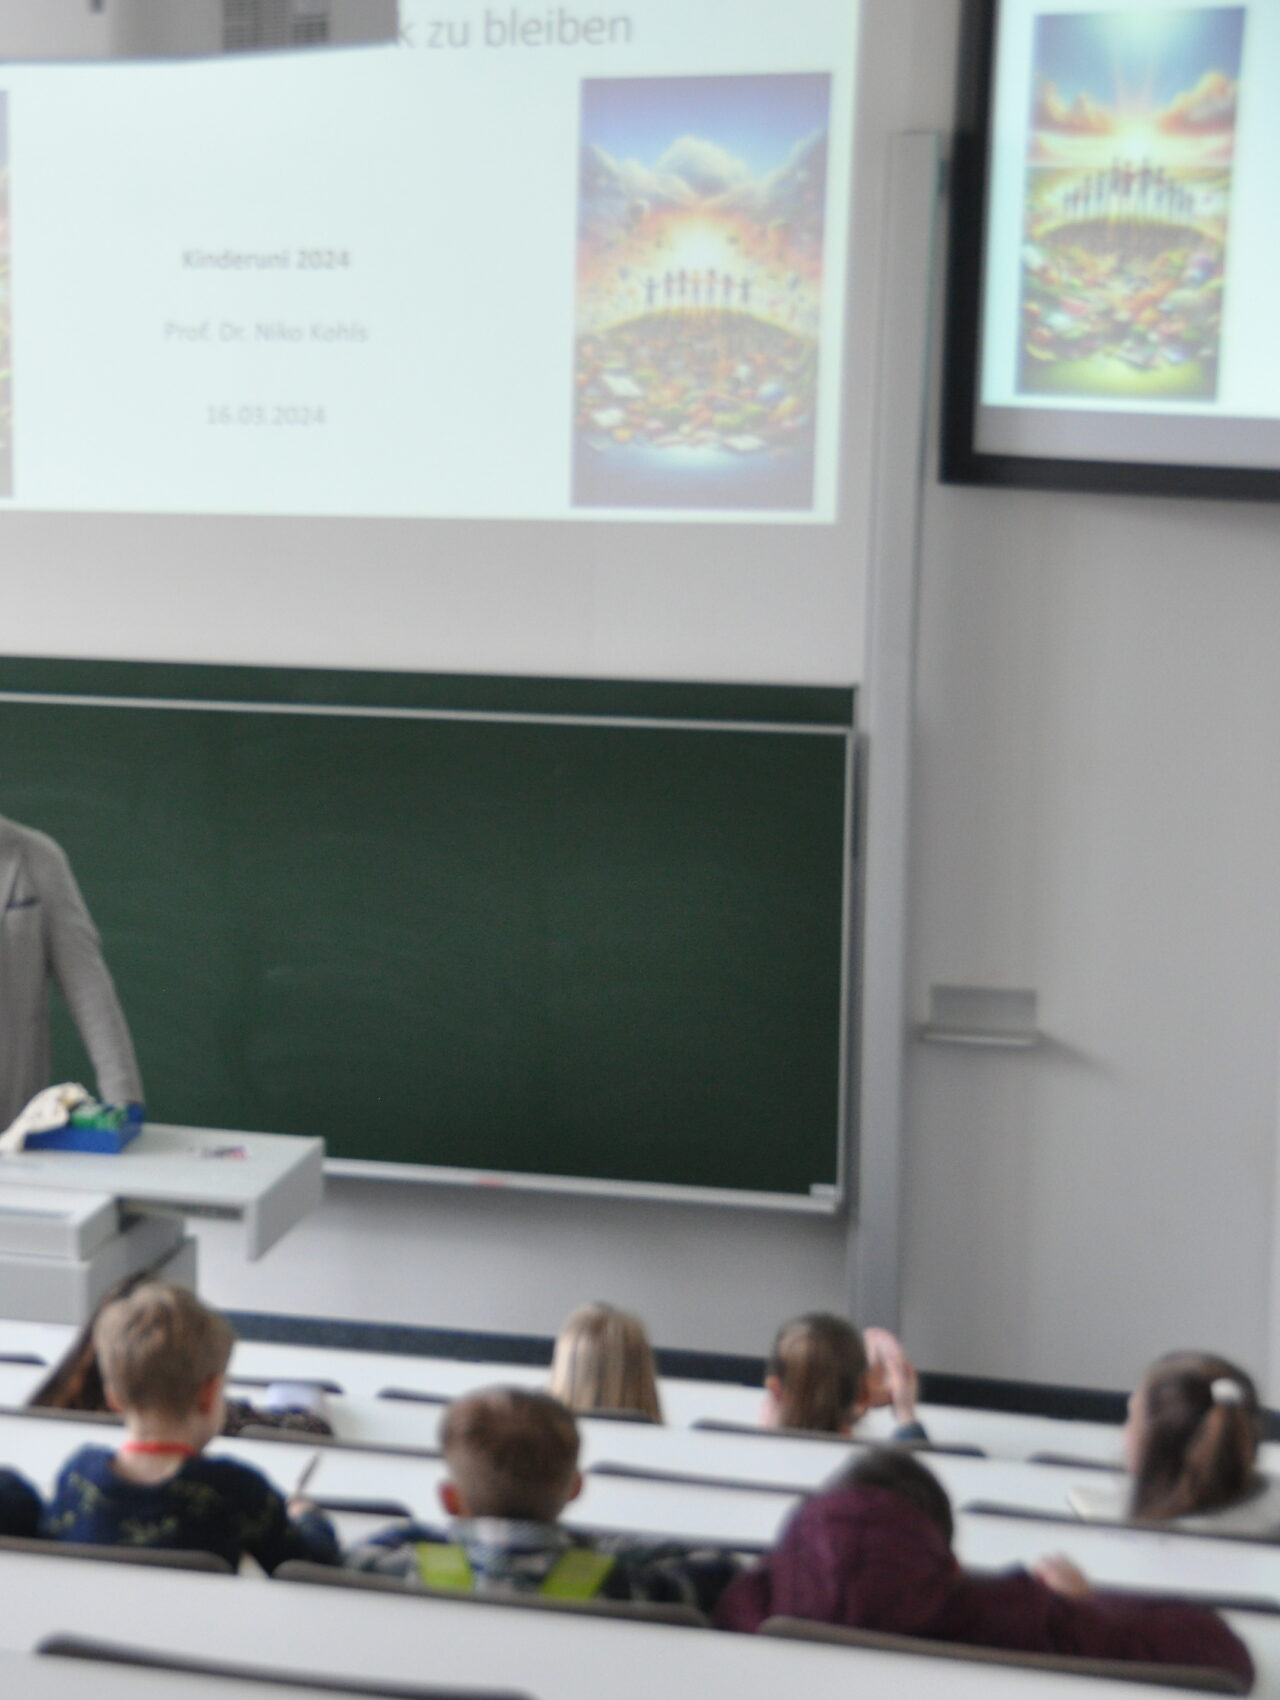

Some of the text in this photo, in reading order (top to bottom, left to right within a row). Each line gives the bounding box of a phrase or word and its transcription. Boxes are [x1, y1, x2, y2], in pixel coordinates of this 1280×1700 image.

[427, 20, 470, 49] zu
[485, 8, 631, 47] bleiben
[183, 249, 349, 269] Kinderuni 2024
[166, 320, 368, 341] Prof. Dr. Niko Kohls
[208, 405, 325, 425] 16.03.2024
